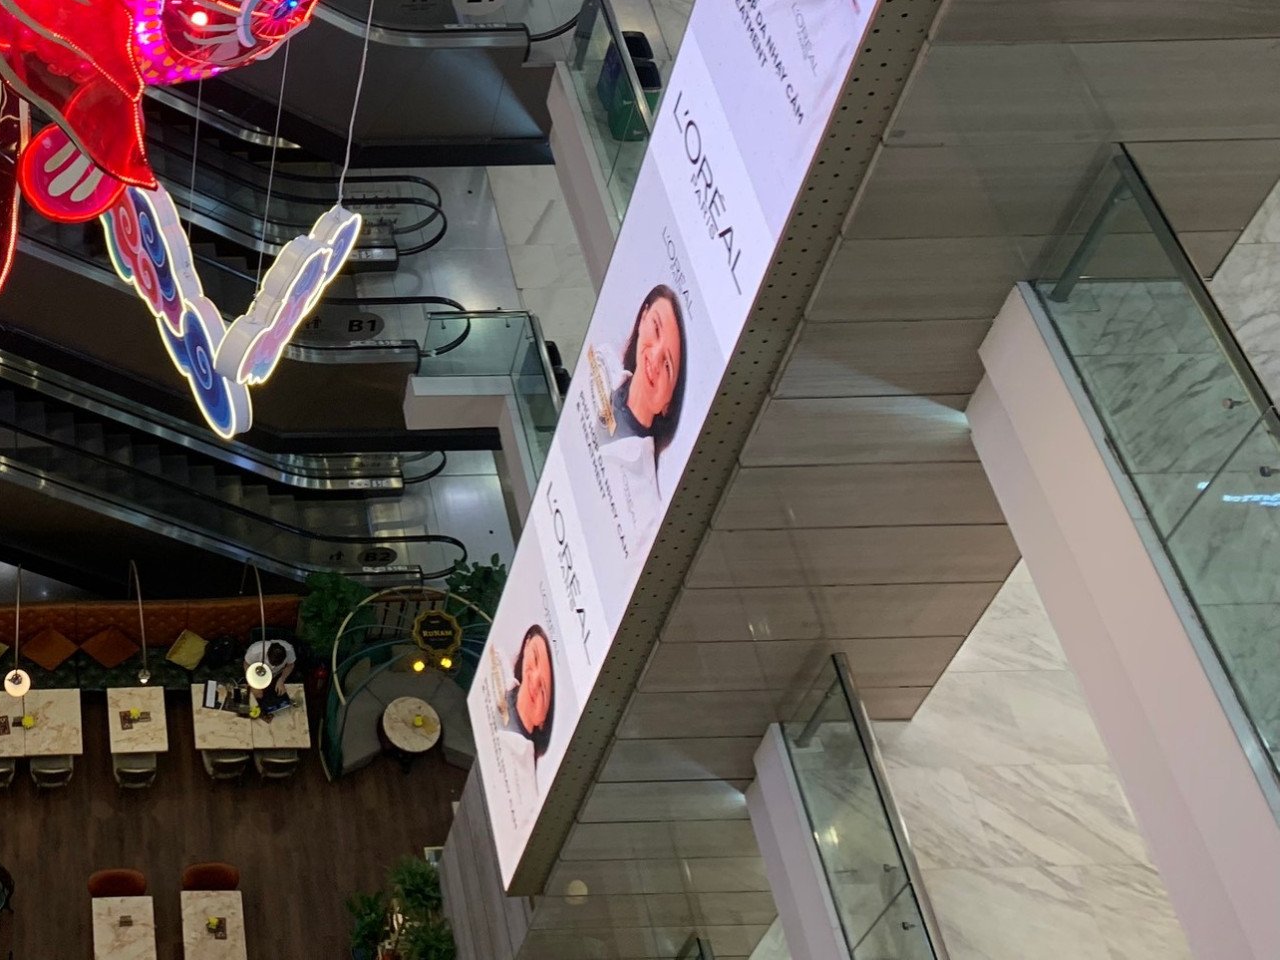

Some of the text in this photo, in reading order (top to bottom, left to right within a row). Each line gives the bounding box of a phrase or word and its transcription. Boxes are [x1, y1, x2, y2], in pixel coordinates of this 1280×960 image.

[674, 91, 742, 296] L'ORÉAL
[348, 319, 377, 333] B1
[364, 551, 392, 561] B2
